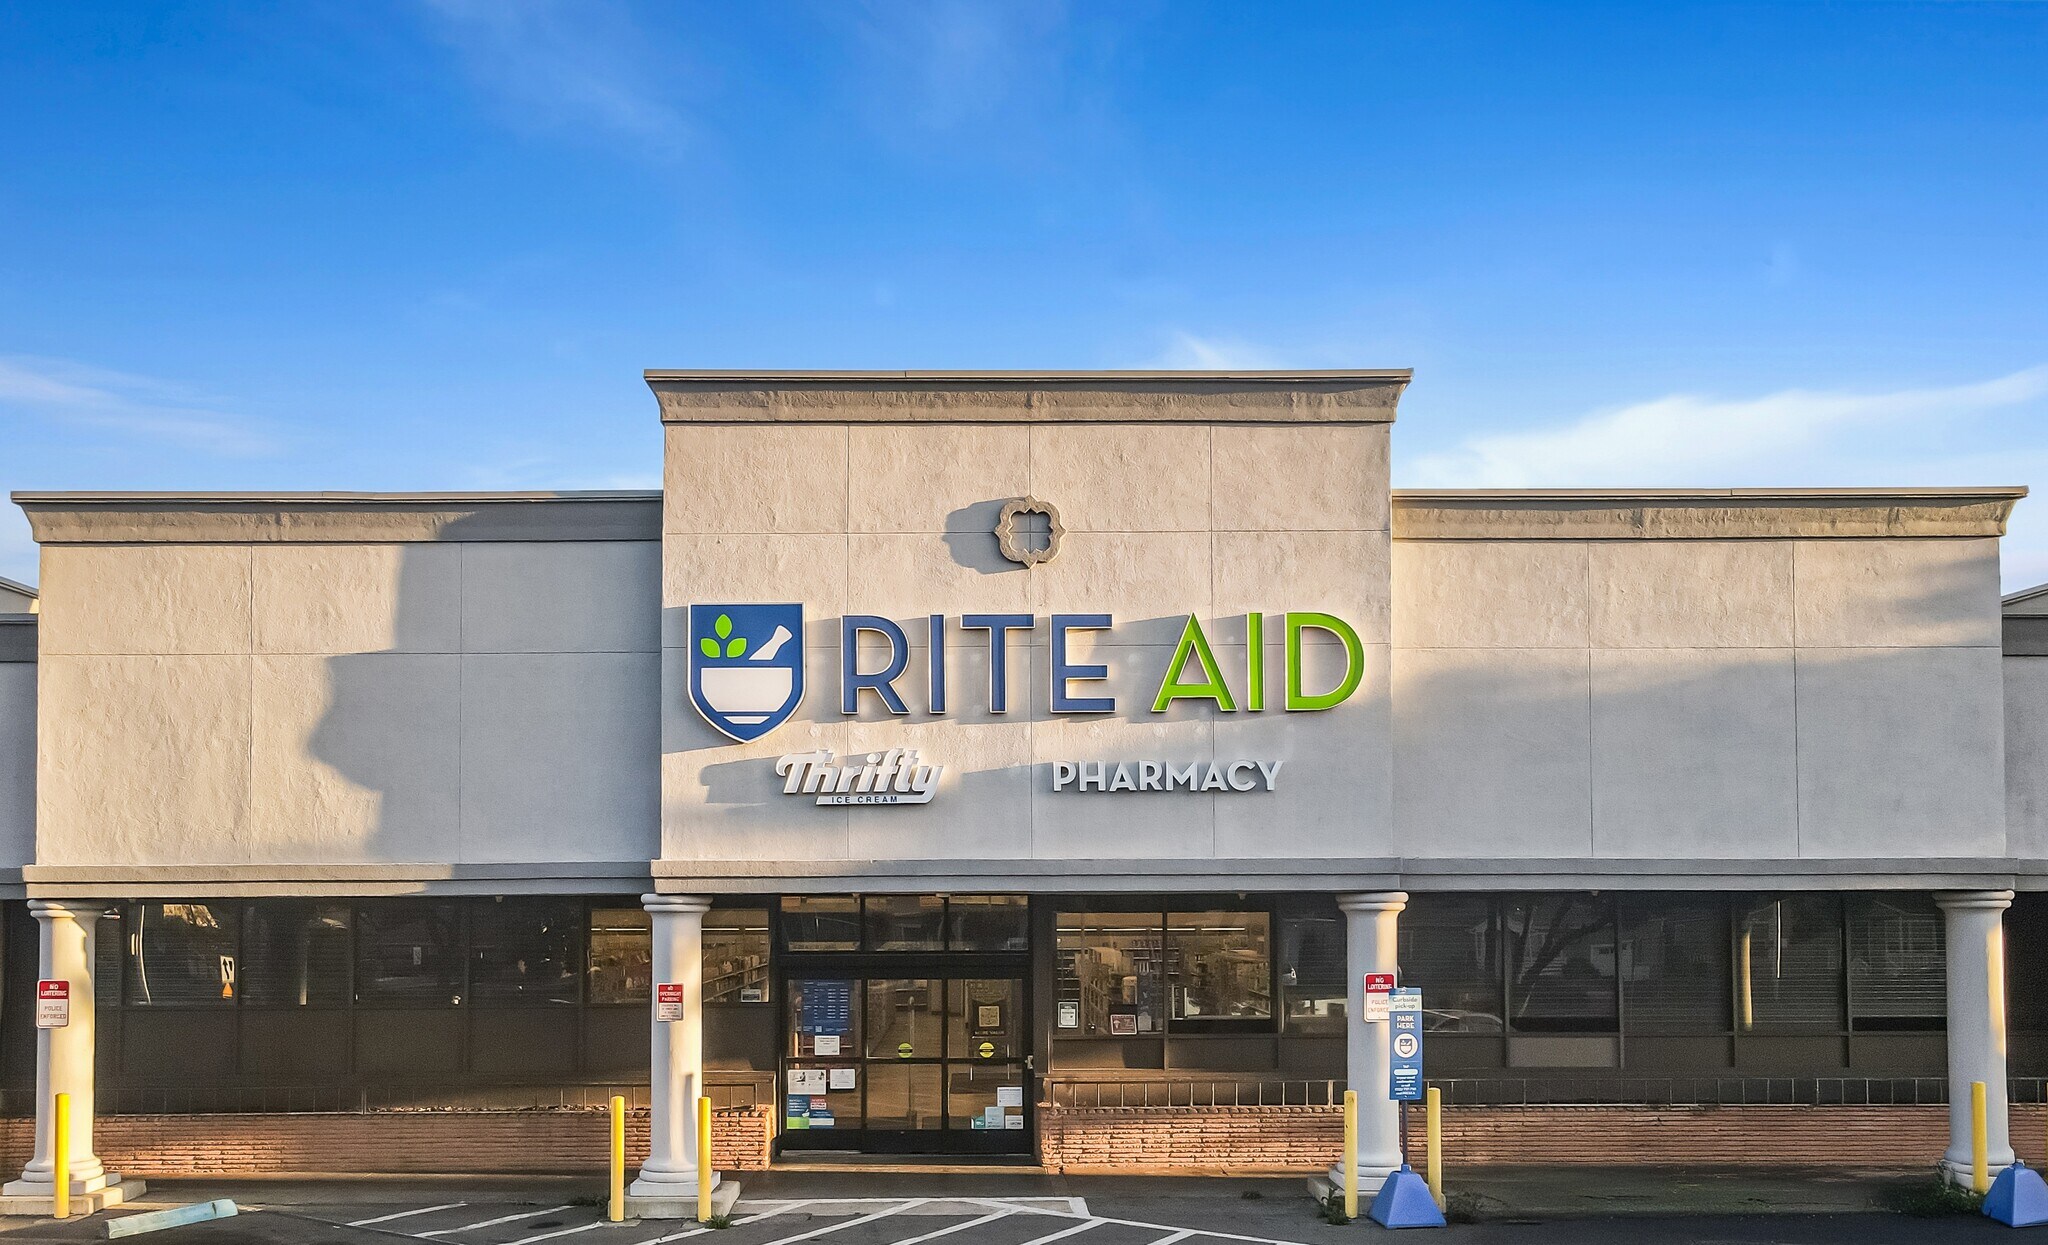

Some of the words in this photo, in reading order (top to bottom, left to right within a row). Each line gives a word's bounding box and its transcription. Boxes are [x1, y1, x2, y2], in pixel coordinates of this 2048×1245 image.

[841, 613, 1116, 715] RITE
[1150, 611, 1366, 712] AID
[775, 748, 944, 805] Thrifty
[1052, 760, 1284, 792] PHARMACY
[831, 796, 851, 804] ICE
